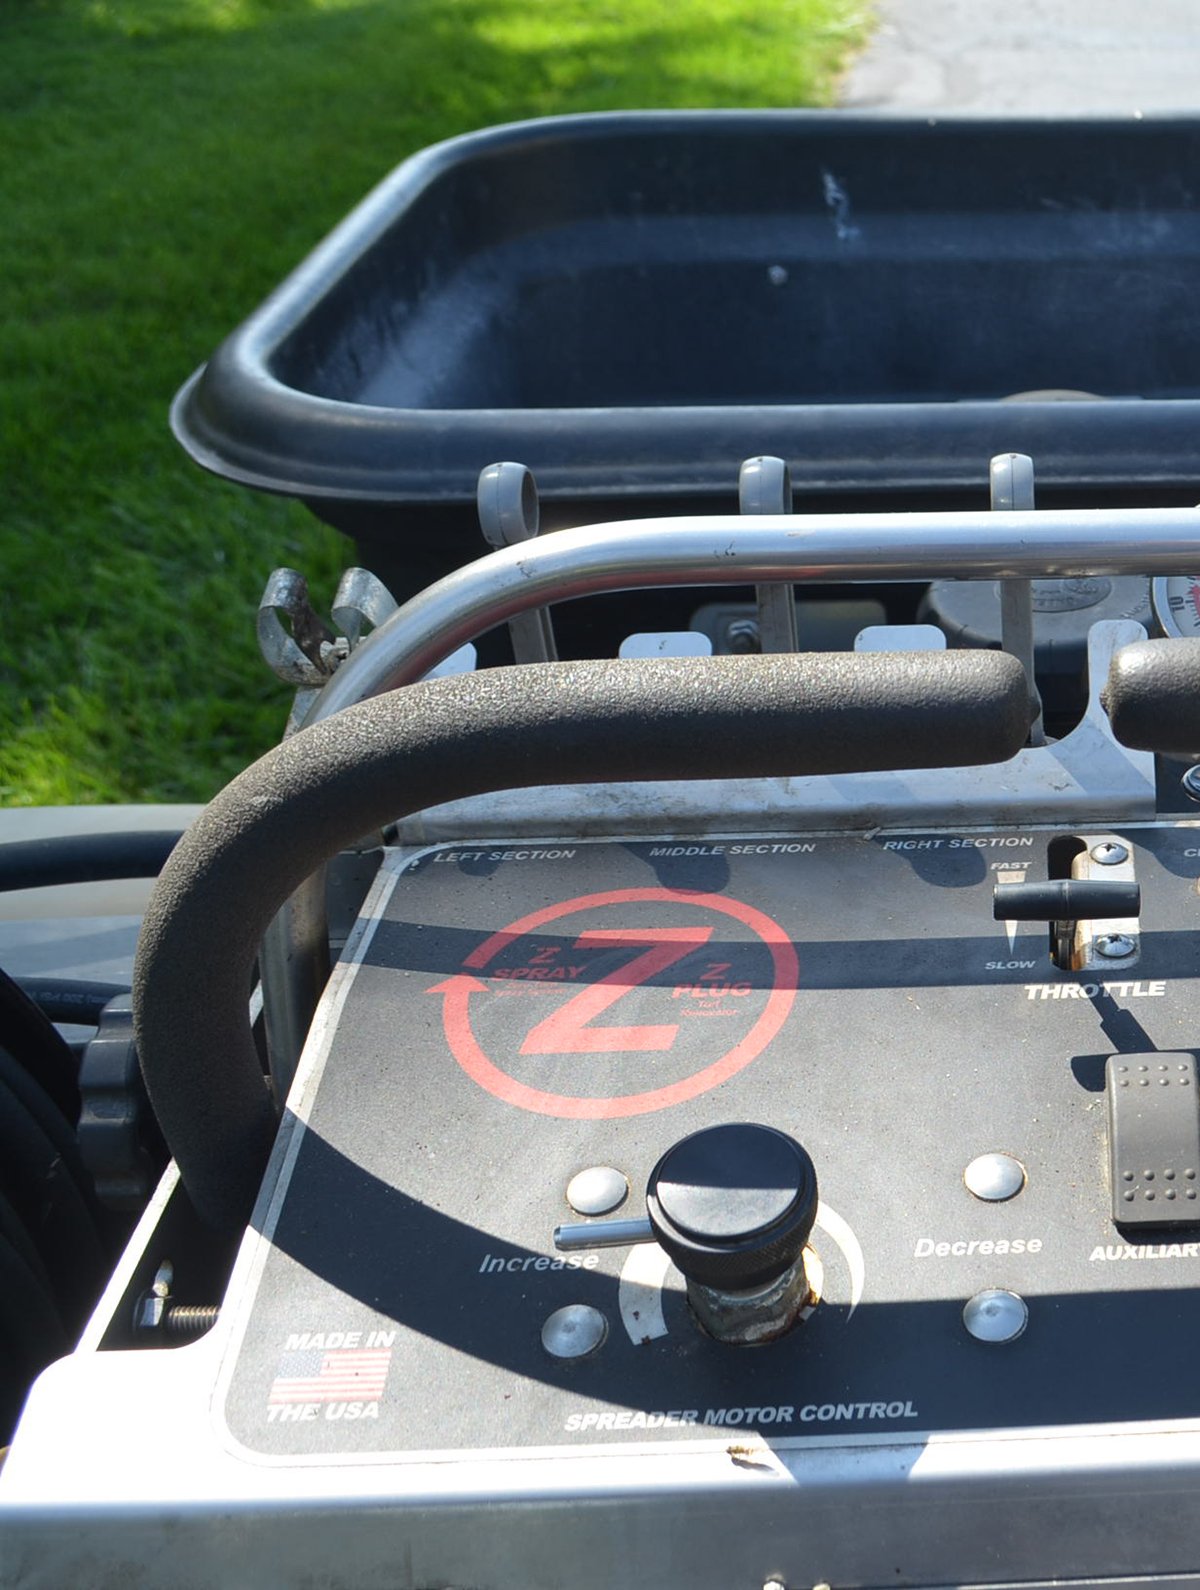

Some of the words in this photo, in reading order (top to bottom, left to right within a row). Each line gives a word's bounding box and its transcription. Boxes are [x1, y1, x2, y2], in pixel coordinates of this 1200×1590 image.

[650, 846, 726, 857] MIDDLE
[729, 843, 817, 855] SECTION
[883, 840, 944, 850] RIGHT
[948, 837, 1034, 849] SECTION
[433, 851, 482, 863] LEFT
[489, 849, 576, 862] SECTION
[990, 862, 1033, 870] FAST
[528, 947, 561, 964] Z
[491, 965, 588, 981] SPRAY
[700, 963, 732, 980] Z
[985, 960, 1036, 970] SLOW
[519, 927, 714, 1054] Z
[671, 981, 753, 998] PLUG
[1024, 981, 1167, 1001] THROTTLE
[914, 1236, 1043, 1259] Decrease
[479, 1252, 600, 1274] Increase
[284, 1331, 363, 1350] MADE
[365, 1330, 396, 1348] IN
[266, 1403, 321, 1423] THE
[325, 1402, 379, 1420] USA
[564, 1409, 699, 1431] SPREADER
[704, 1405, 793, 1426] MOTOR
[799, 1401, 919, 1421] CONTROL
